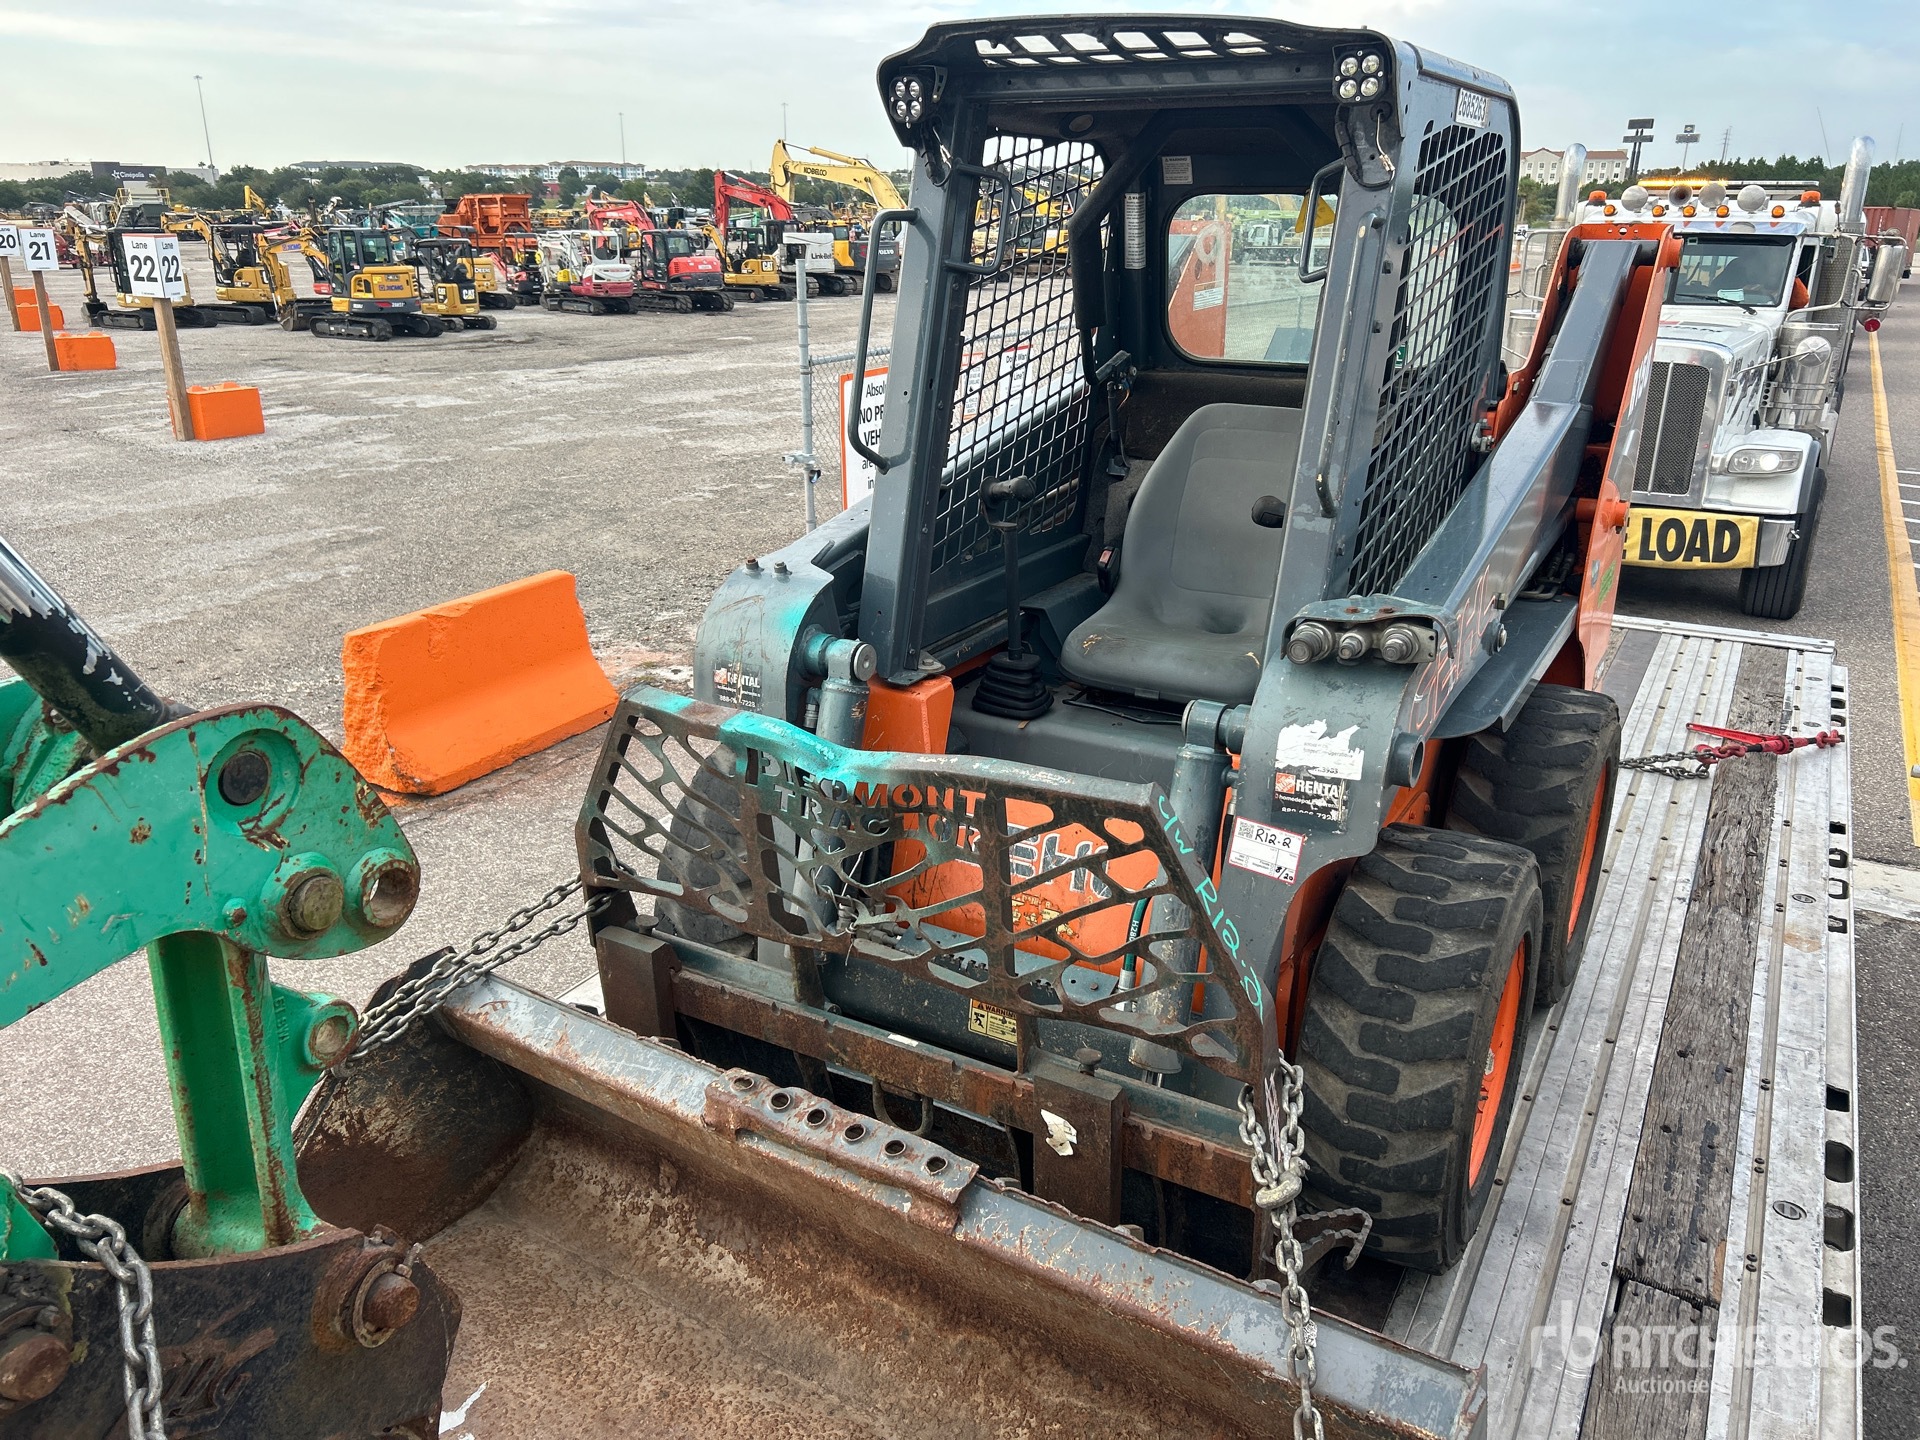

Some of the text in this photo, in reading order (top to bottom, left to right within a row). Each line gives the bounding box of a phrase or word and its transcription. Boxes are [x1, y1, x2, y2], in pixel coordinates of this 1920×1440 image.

[804, 167, 827, 176] KOBELCO
[0, 234, 16, 249] 20
[131, 240, 148, 250] Lane
[161, 241, 174, 250] Lane
[29, 241, 51, 261] 21
[130, 254, 158, 283] 22
[162, 254, 182, 283] 22
[762, 262, 773, 271] CAT
[462, 288, 475, 300] CAT
[866, 382, 886, 398] Absol
[860, 408, 873, 423] NO
[864, 431, 881, 447] VEH
[1638, 517, 1741, 564] LOAD
[745, 747, 987, 819] PIEDMONT
[1295, 779, 1343, 799] RENTA
[773, 783, 982, 854] TRACTOR
